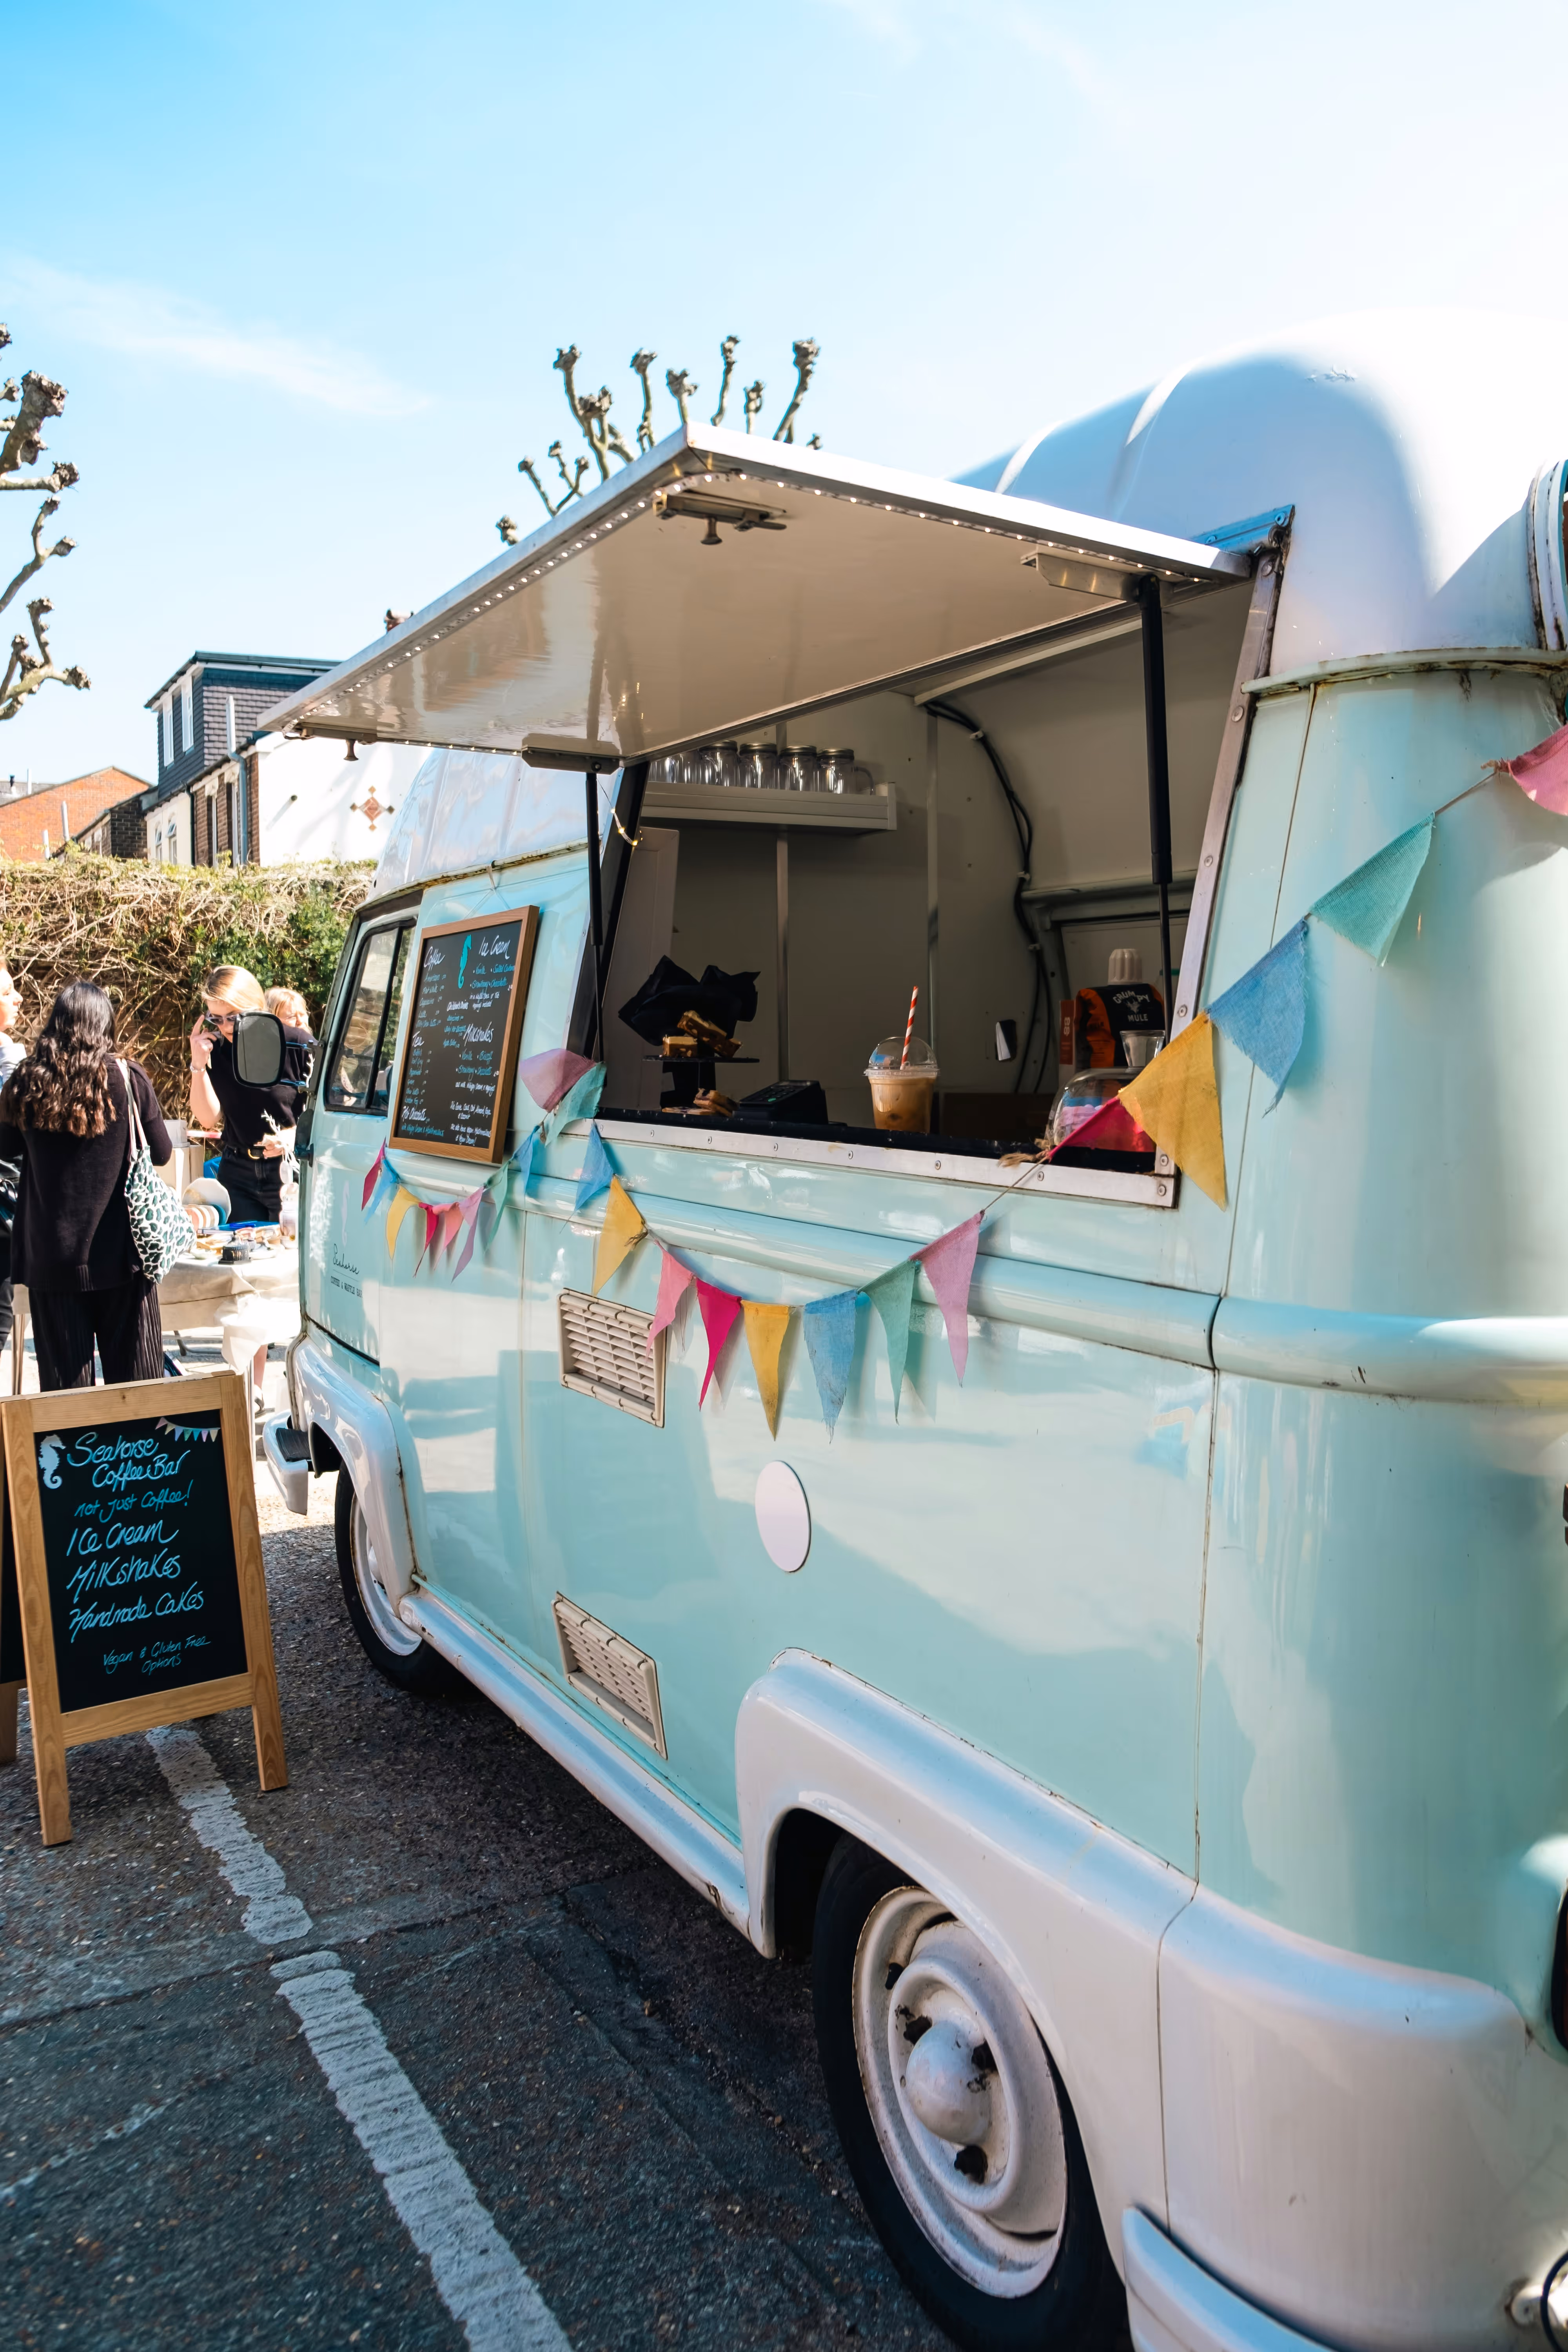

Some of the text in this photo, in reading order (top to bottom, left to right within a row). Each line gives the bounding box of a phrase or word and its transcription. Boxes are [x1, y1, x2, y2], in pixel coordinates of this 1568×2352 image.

[424, 946, 445, 971] Coffee
[1112, 991, 1150, 1004] GRUMPY
[412, 1031, 425, 1047] Tea
[67, 1432, 159, 1466] Seahorse
[93, 1450, 191, 1492] Coffee Bar
[74, 1500, 100, 1517] not
[106, 1520, 179, 1549] Cream
[69, 1581, 203, 1643] Handmade Cakes
[103, 1649, 133, 1674] Vegan
[151, 1641, 181, 1657] Gluten
[185, 1635, 211, 1648] Free
[142, 1653, 181, 1675] Options
